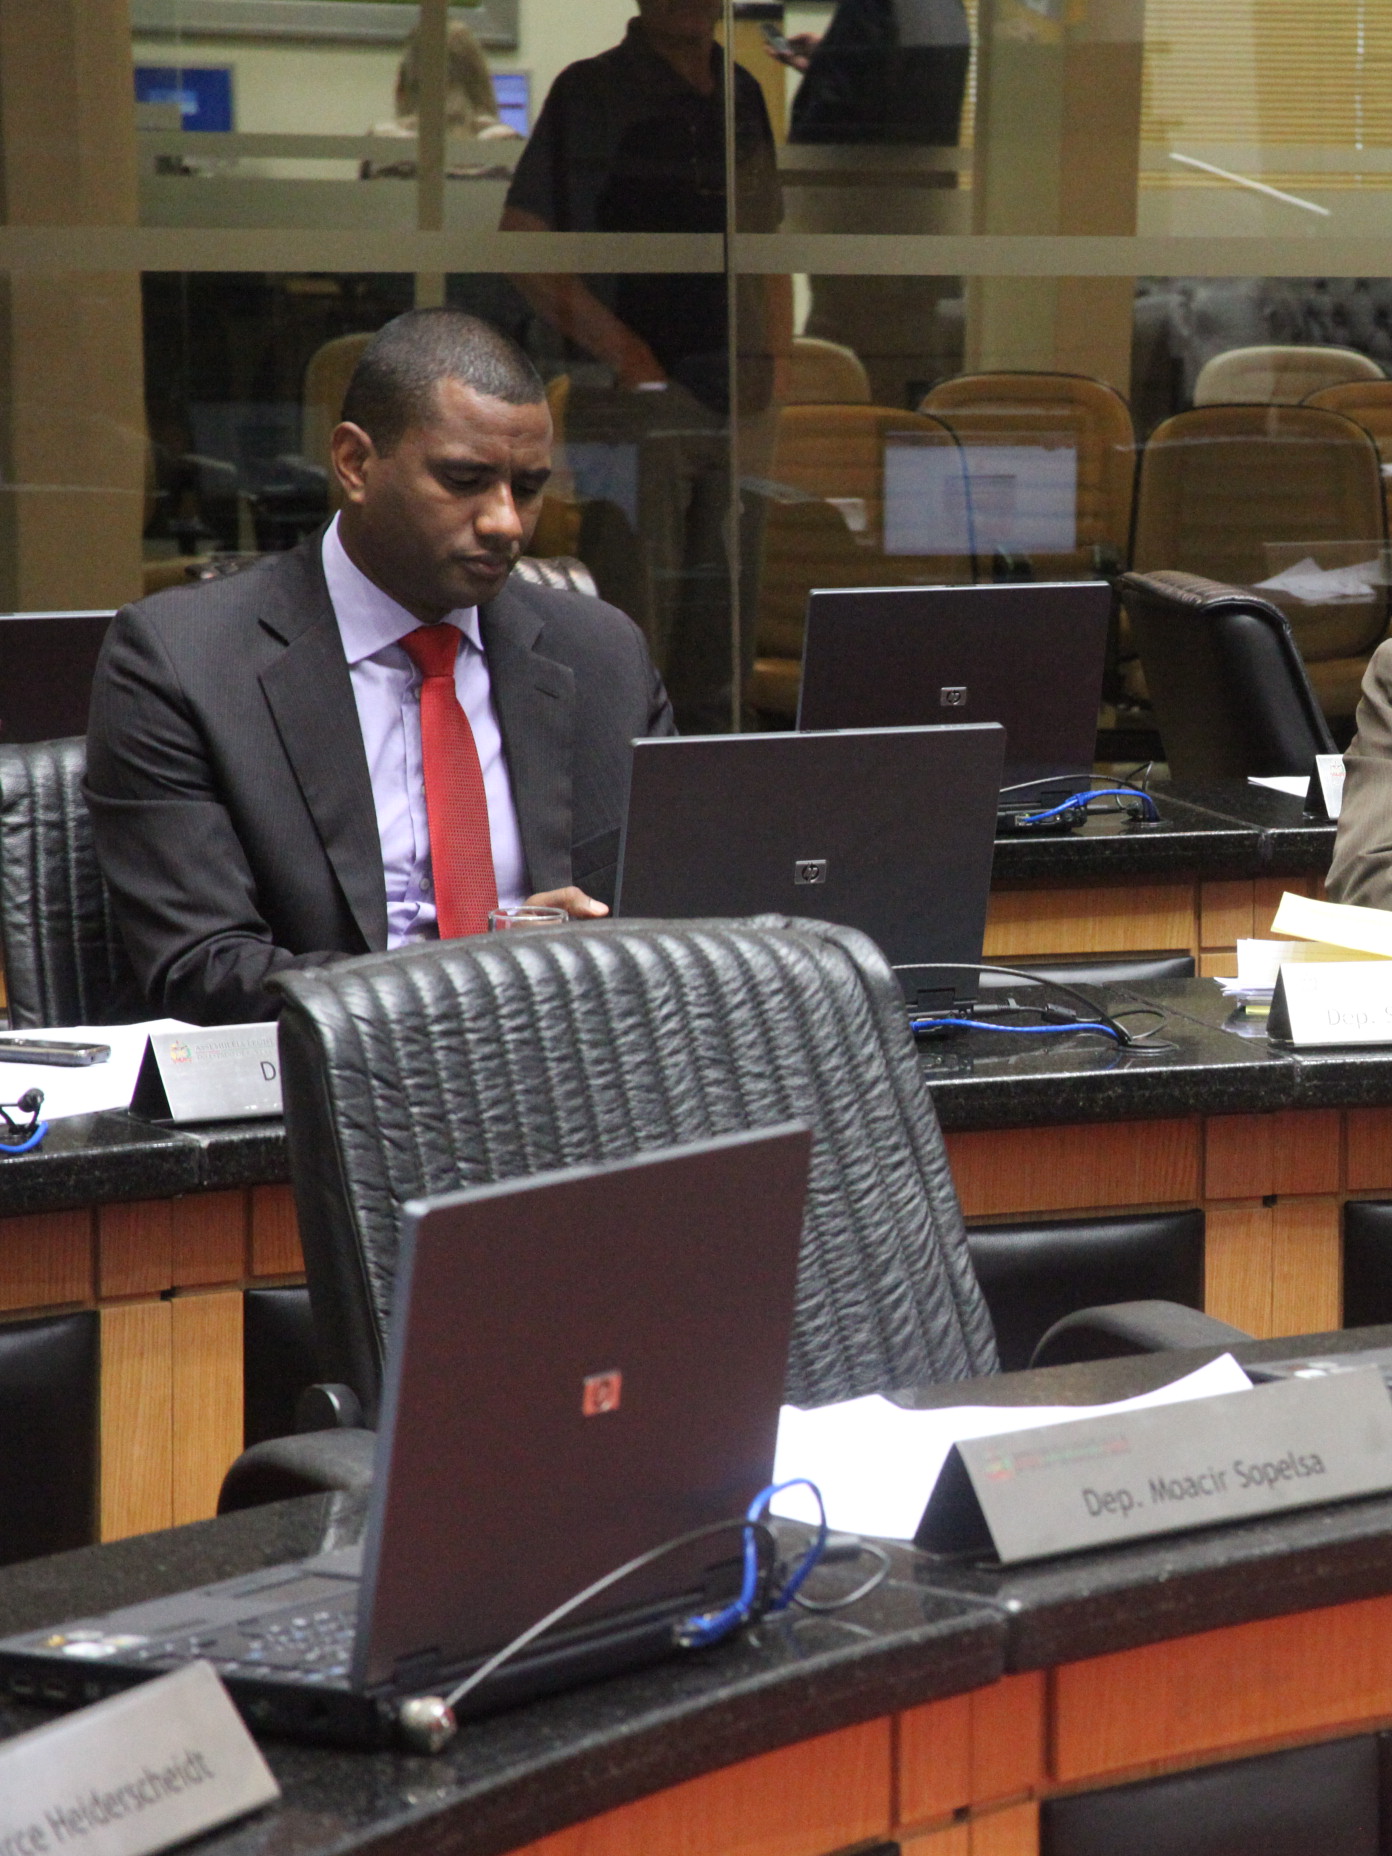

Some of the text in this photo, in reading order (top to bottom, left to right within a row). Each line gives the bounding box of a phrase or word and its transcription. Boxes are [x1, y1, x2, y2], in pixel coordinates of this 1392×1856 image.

[1327, 1009, 1375, 1029] Dep.
[1082, 1452, 1326, 1518] Dep. Moacir Sopelsa
